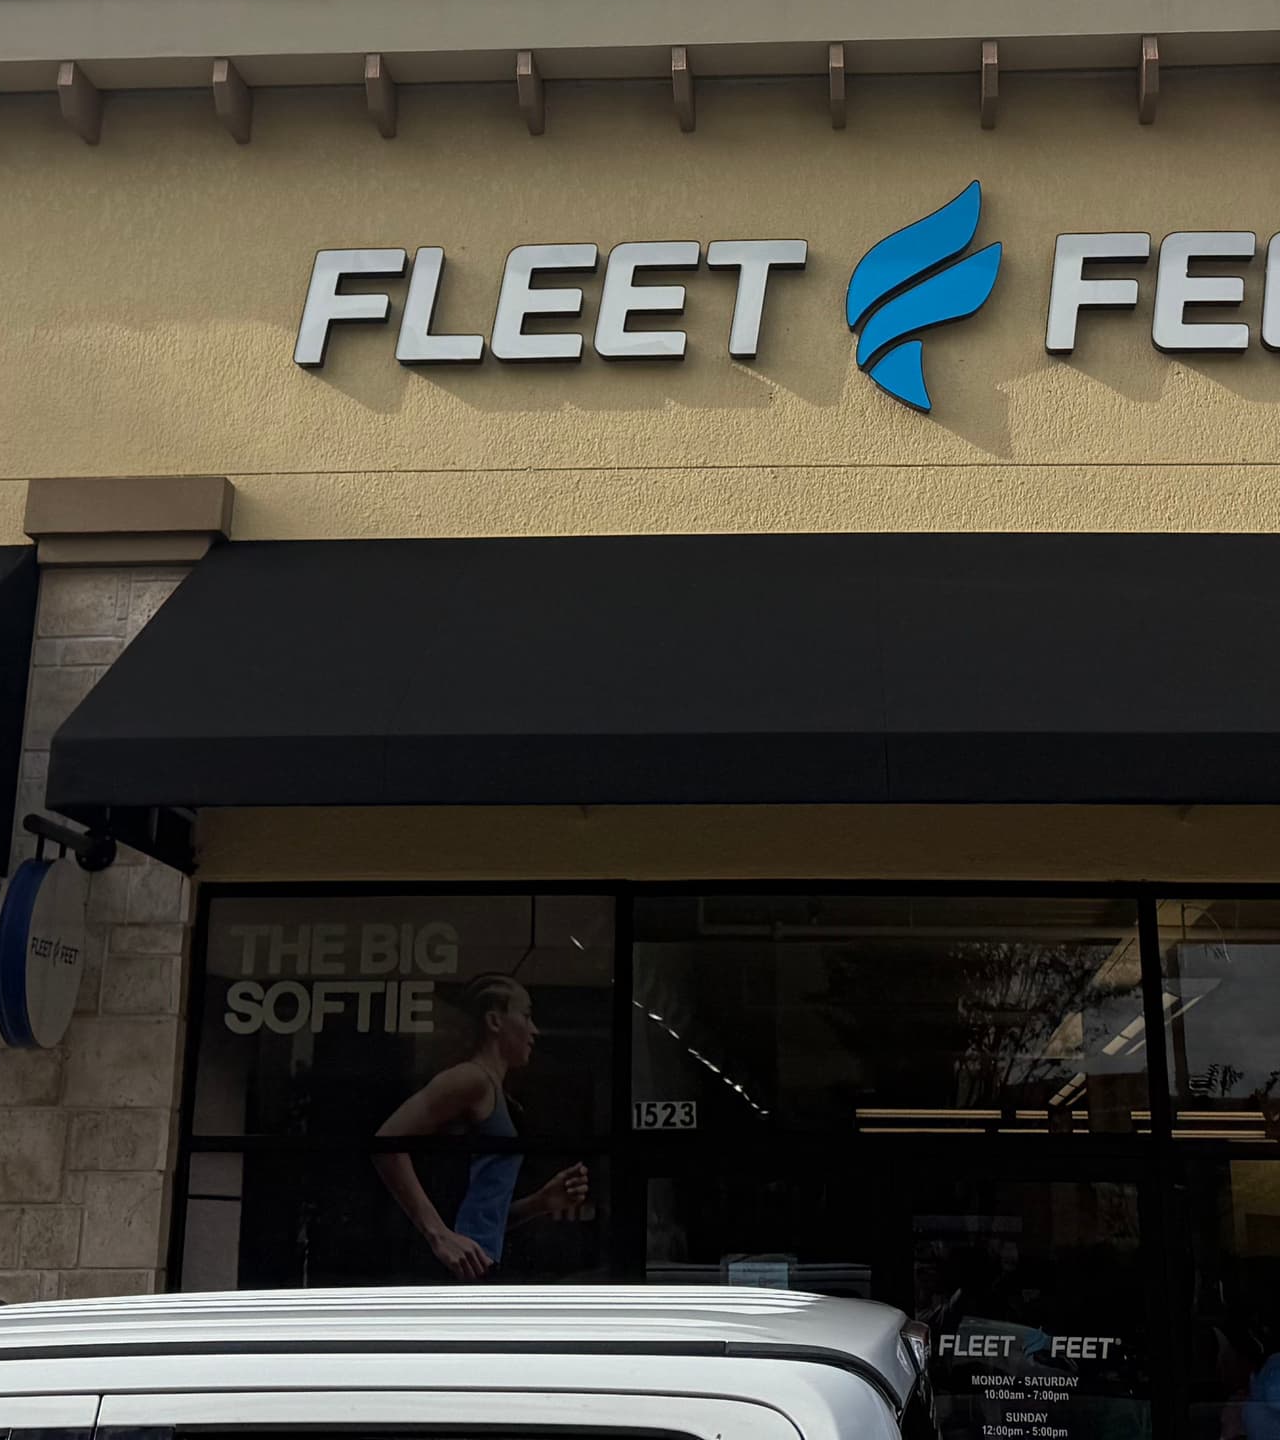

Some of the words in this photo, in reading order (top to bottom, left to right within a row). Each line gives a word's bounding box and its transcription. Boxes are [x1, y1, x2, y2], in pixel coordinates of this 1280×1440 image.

[294, 239, 808, 367] FLEET
[32, 937, 53, 958] FLEET
[61, 945, 79, 965] FEET
[228, 924, 347, 975] THE
[360, 921, 459, 975] BIG
[223, 980, 435, 1035] SOFTIE
[635, 1103, 694, 1127] 1523
[938, 1335, 1016, 1357] FLEET
[1051, 1336, 1114, 1359] FEET
[971, 1375, 1016, 1387] MONDAY
[1024, 1375, 1080, 1388] SATURDAY
[984, 1390, 1025, 1401] 10:00am
[1033, 1390, 1070, 1402] 7:00pm
[1005, 1412, 1048, 1424] SUNDAY
[982, 1424, 1024, 1437] 12:00pm
[1032, 1426, 1069, 1439] 5:00pm
